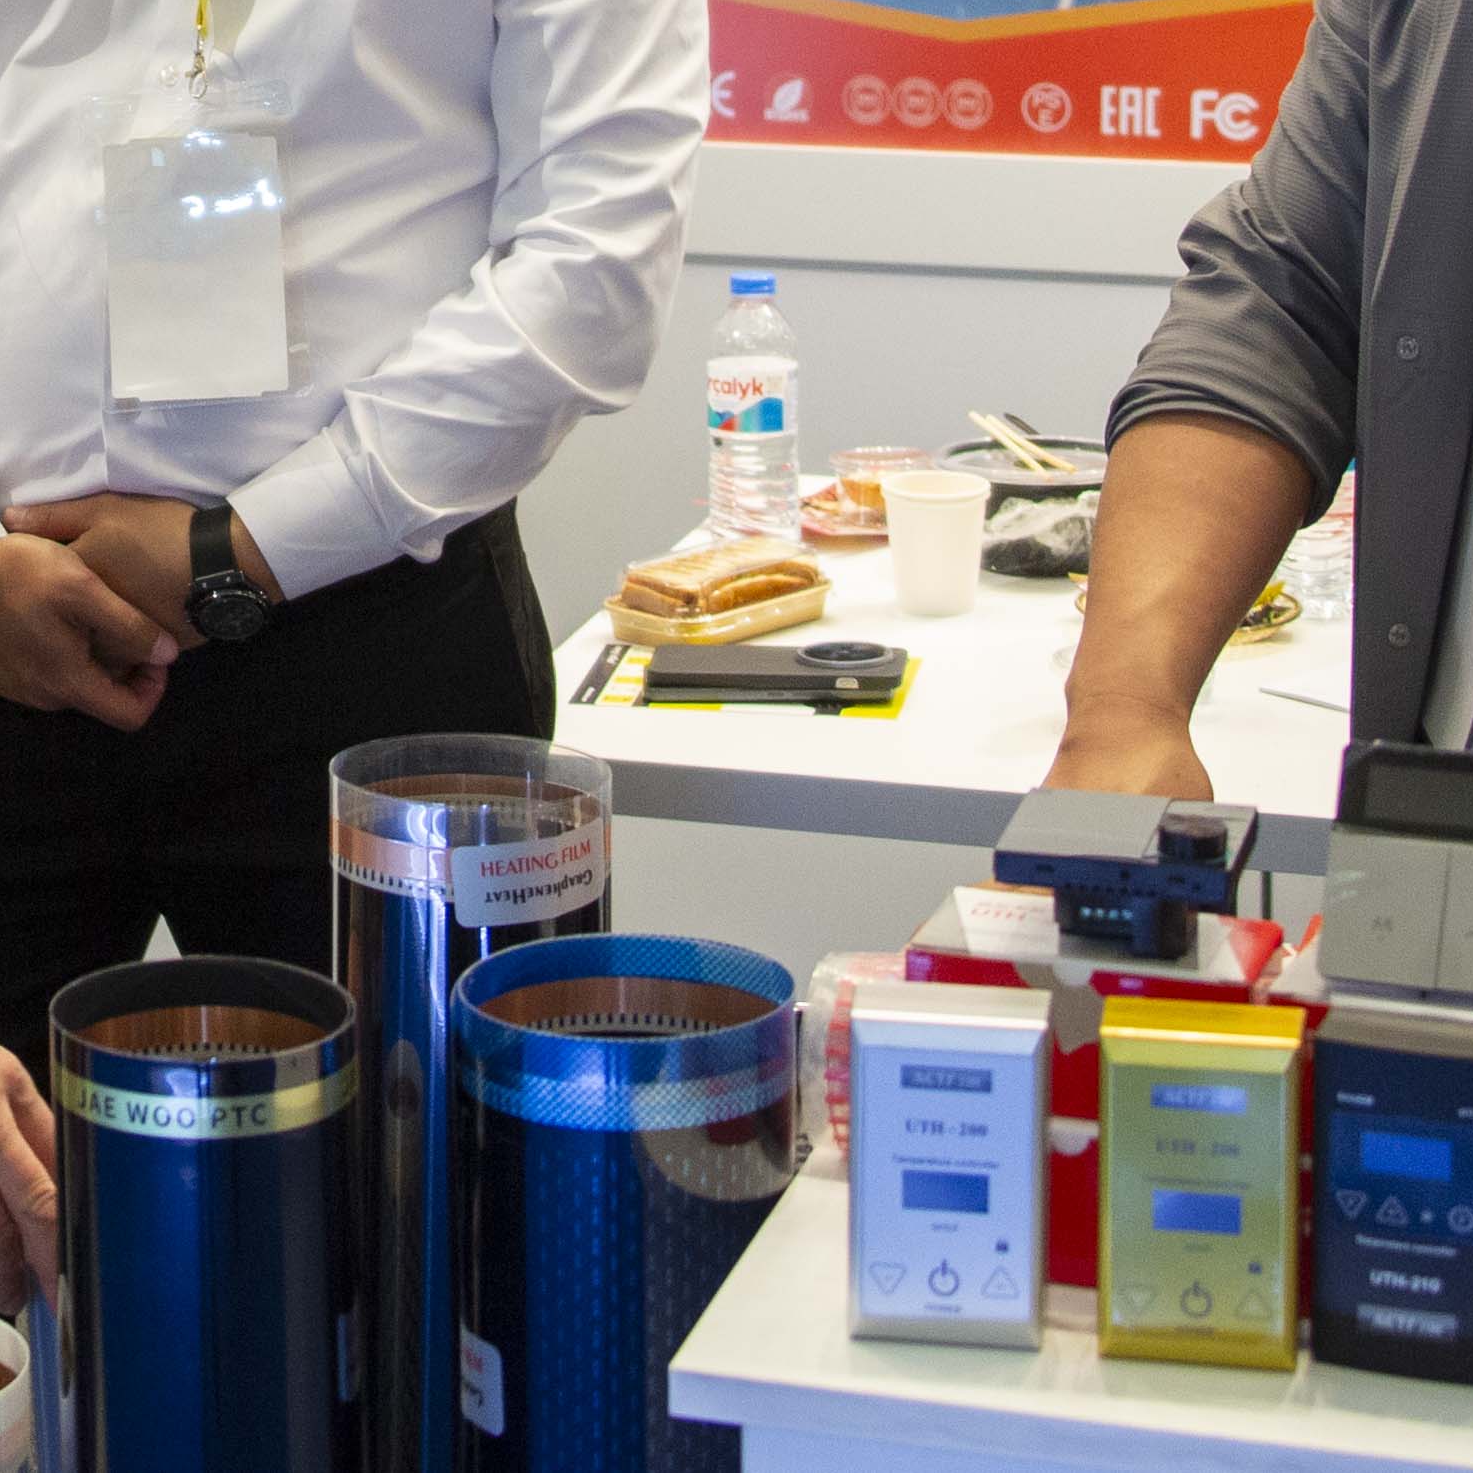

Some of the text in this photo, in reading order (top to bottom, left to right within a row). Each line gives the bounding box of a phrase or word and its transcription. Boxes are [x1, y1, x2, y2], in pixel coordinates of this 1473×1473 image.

[479, 839, 592, 878] HEATING FILM
[78, 1089, 267, 1129] JAE WOO PTC
